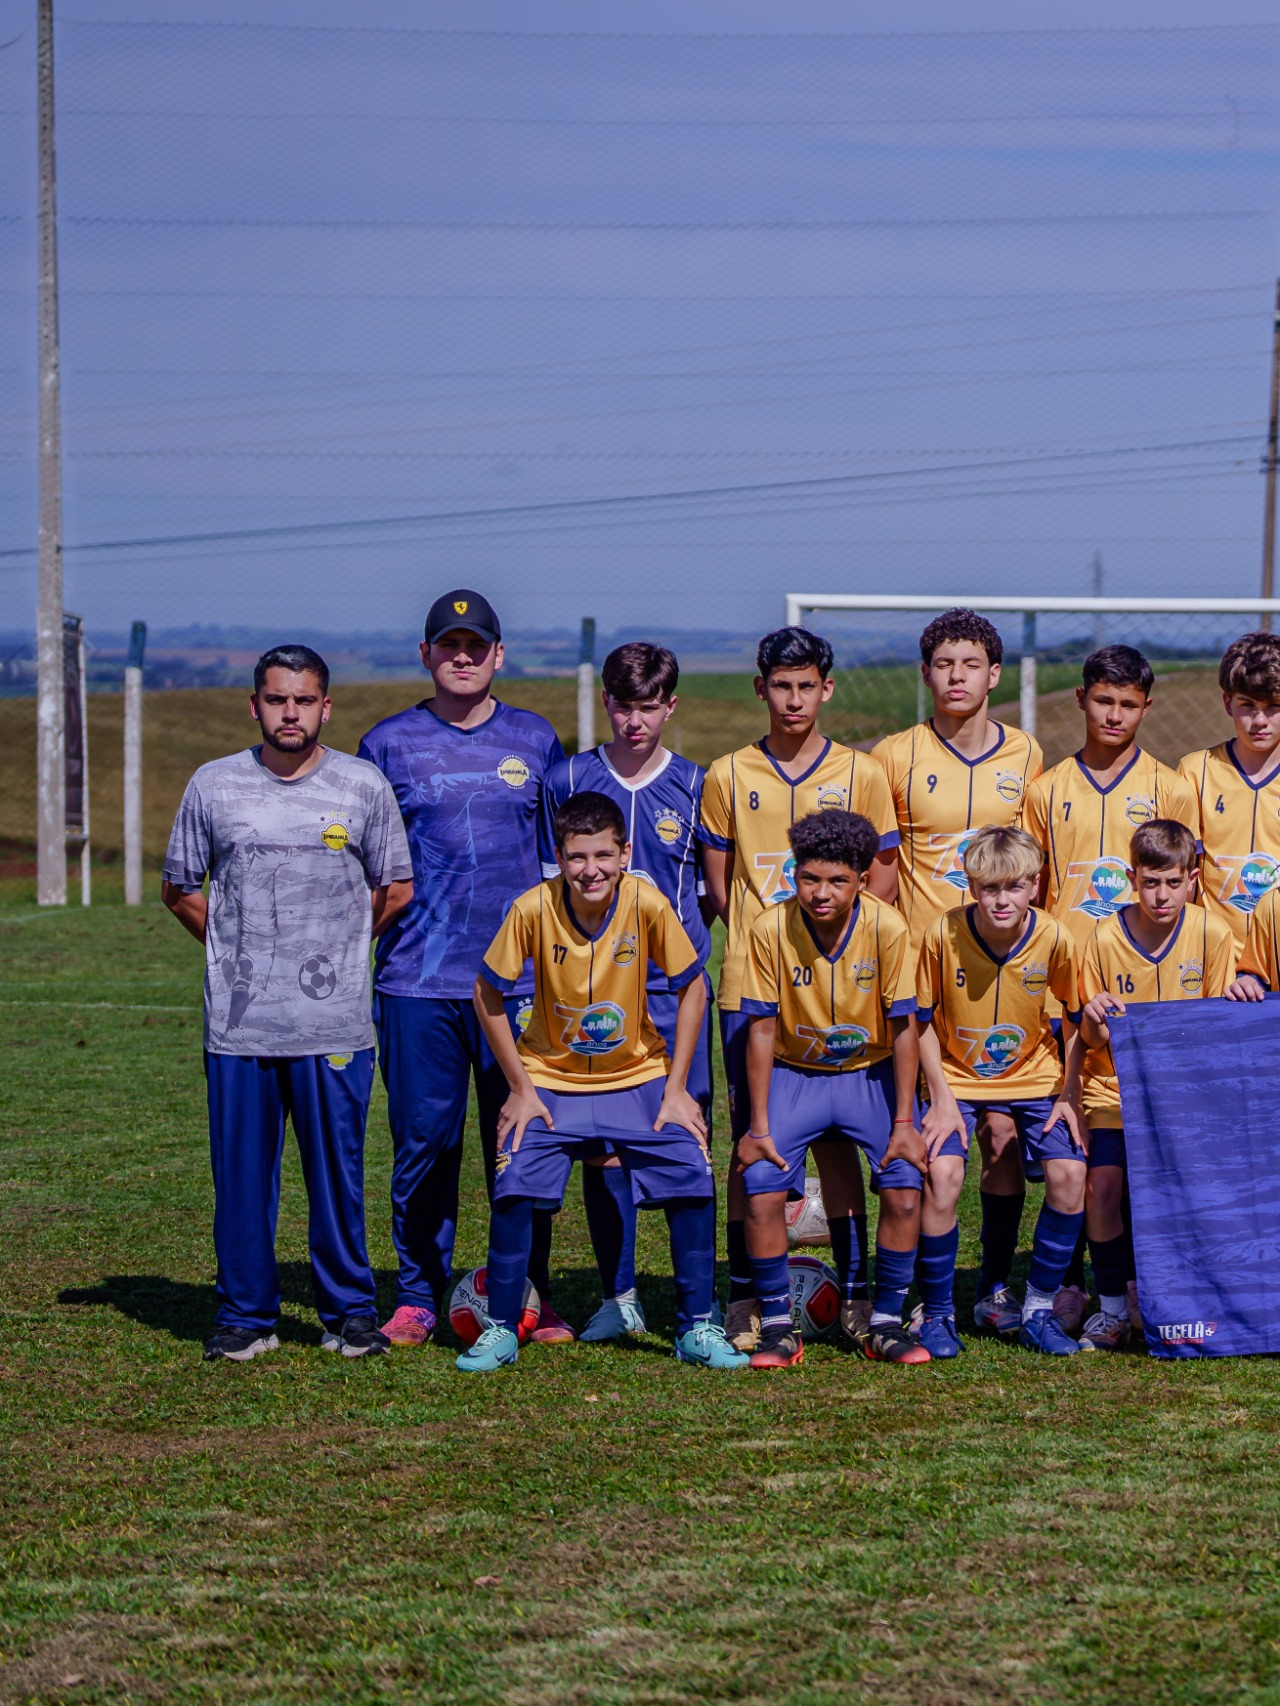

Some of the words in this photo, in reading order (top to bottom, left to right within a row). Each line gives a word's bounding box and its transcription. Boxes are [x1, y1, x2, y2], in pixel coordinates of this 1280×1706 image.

[926, 774, 938, 794] 9
[748, 790, 760, 811] 8
[1214, 794, 1225, 814] 4
[1062, 801, 1072, 822] 7
[1094, 900, 1115, 909] anos
[552, 943, 568, 966] 17
[792, 966, 813, 987] 20
[955, 968, 966, 988] 5
[1116, 973, 1135, 995] 16
[586, 1040, 608, 1049] anos
